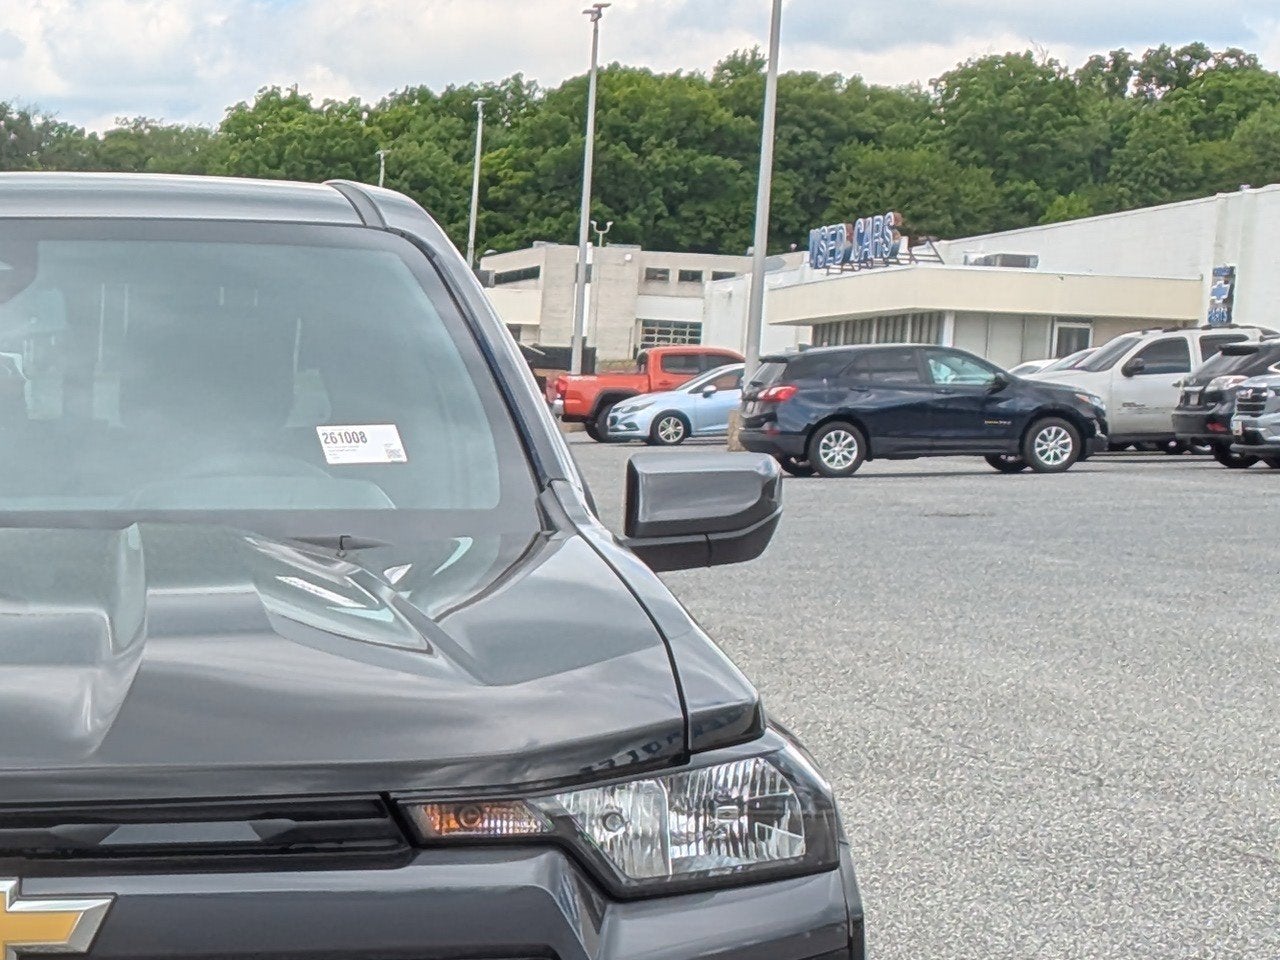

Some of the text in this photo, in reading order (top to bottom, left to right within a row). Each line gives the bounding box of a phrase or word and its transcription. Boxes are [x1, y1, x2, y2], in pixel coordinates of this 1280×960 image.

[809, 211, 894, 269] USED CARS
[321, 431, 368, 445] 261008
